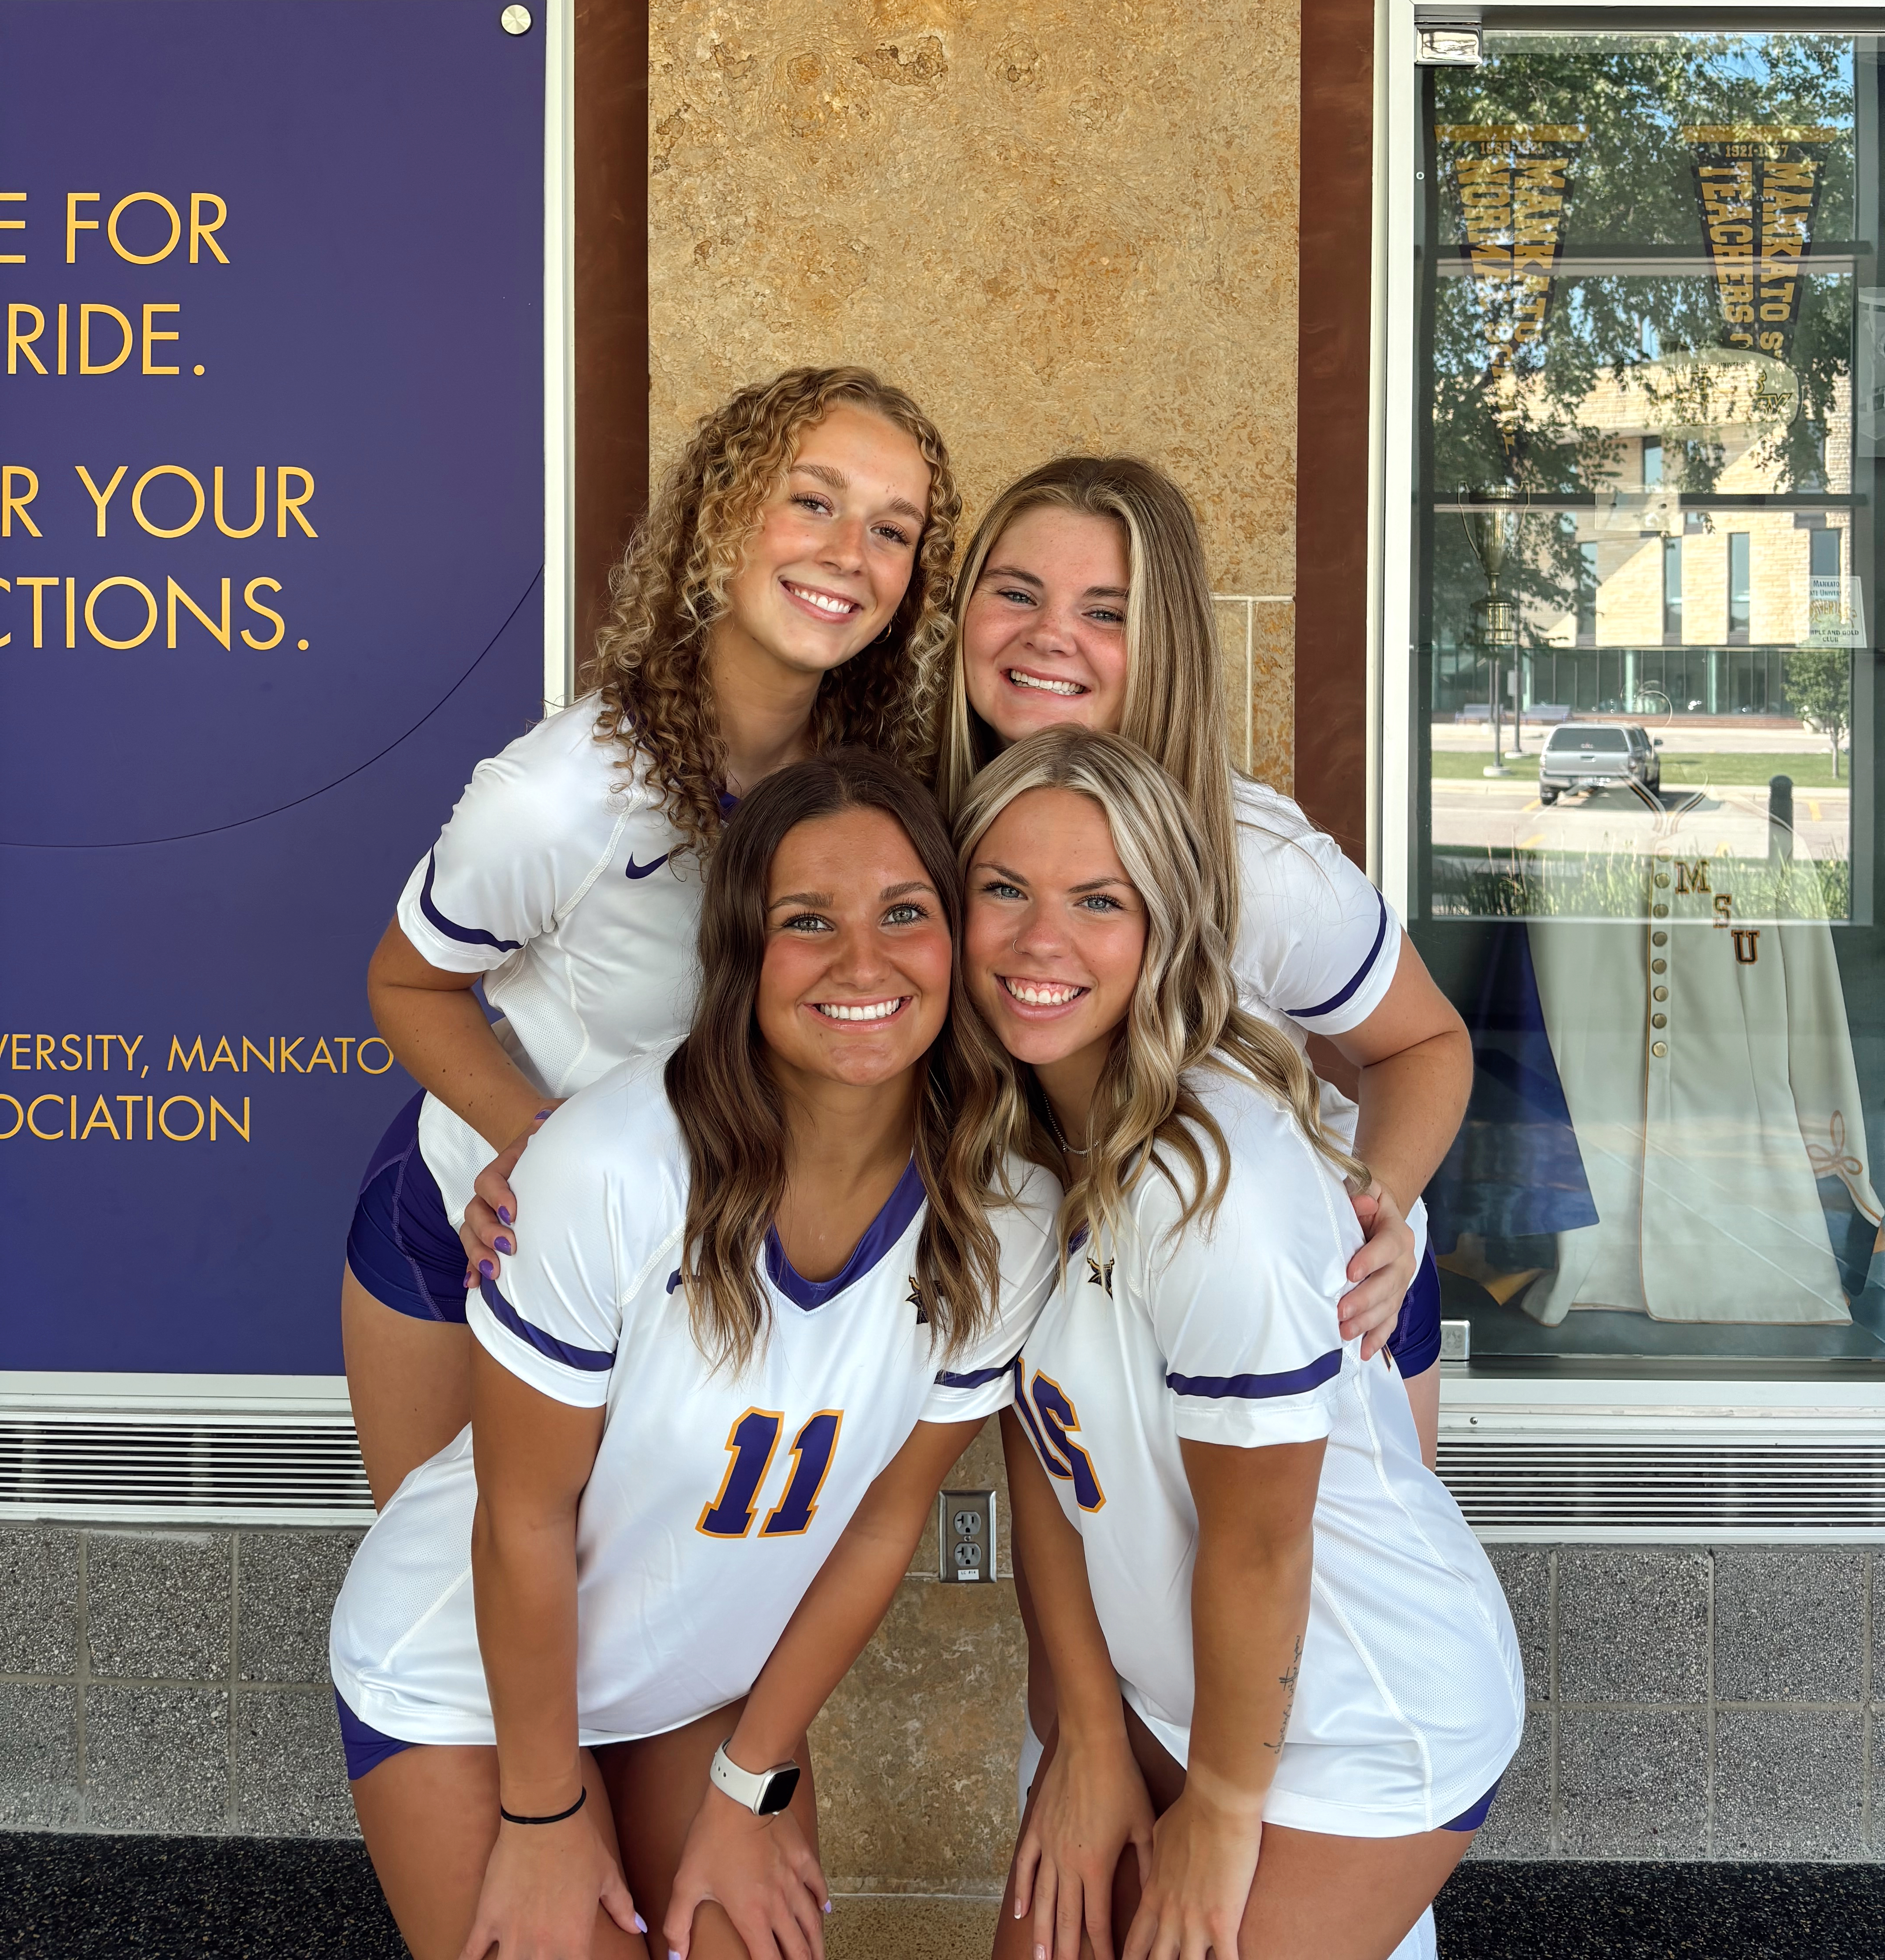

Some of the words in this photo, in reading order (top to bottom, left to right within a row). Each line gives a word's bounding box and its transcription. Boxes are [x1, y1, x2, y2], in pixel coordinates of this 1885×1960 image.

[66, 192, 230, 264] FOR
[1514, 158, 1569, 343] MANKATO
[1698, 161, 1755, 323] TEACHERS
[1760, 161, 1817, 322] MANKATO
[7, 303, 205, 376] RIDE.
[75, 465, 319, 539] YOUR
[0, 575, 309, 652] TIONS.
[167, 1035, 394, 1074] MANKATO
[695, 1406, 844, 1539] 11
